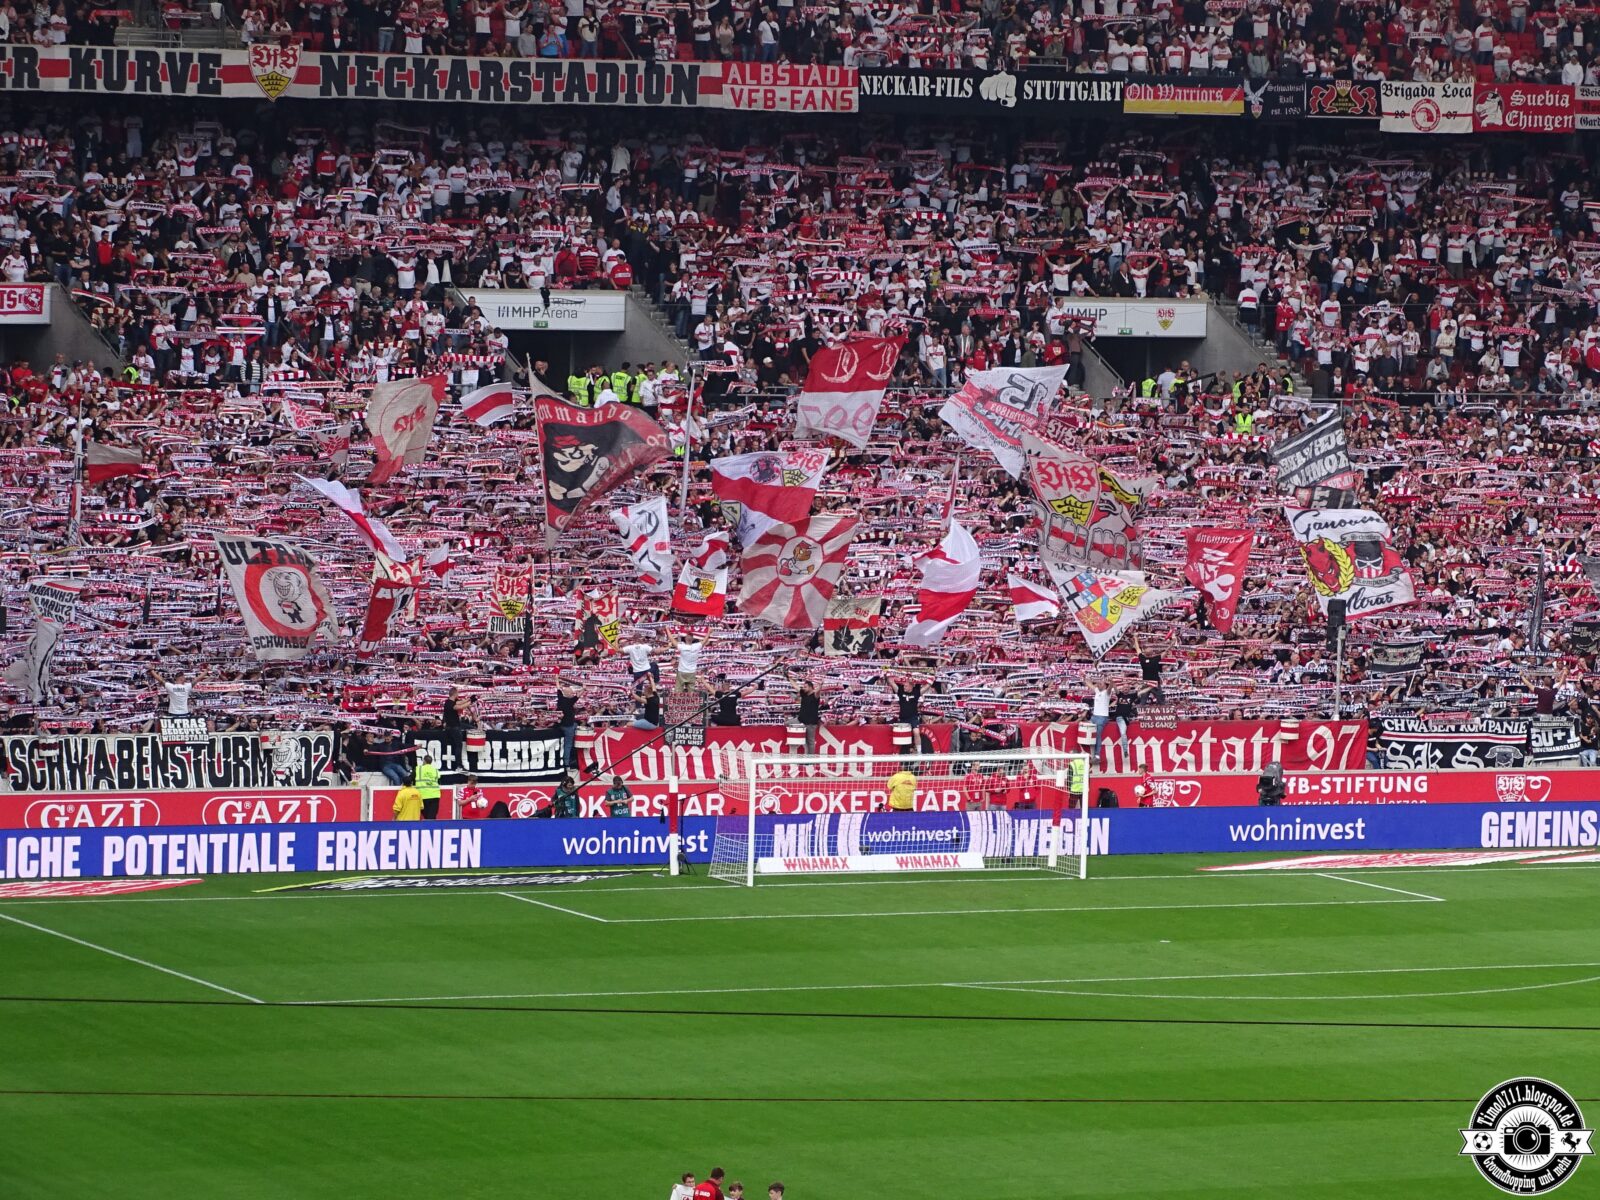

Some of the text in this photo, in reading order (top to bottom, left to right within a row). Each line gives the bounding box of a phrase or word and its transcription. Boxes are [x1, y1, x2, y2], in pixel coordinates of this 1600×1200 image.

[69, 48, 223, 95] KURVE
[320, 55, 700, 105] NECKARSTADION
[727, 64, 855, 86] ALBSTADT
[860, 74, 1124, 102] NECKAR-FILS STUTTGART
[1126, 83, 1153, 101] Old
[1157, 83, 1223, 103] Warriors
[1382, 83, 1473, 100] Brigada Loca
[1510, 90, 1570, 108] Suebia
[730, 88, 854, 111] VFB-FANS
[542, 306, 578, 319] Arena
[1036, 460, 1097, 492] VfB
[161, 718, 207, 728] ULTRAS
[1306, 724, 1361, 771] 97
[1531, 728, 1580, 747] 50+1
[477, 737, 565, 771] BLEIBT!
[1286, 776, 1428, 793] fB-STIFTUNG
[792, 789, 961, 813] JOKERTAR
[868, 826, 959, 843] wohninvest
[1230, 817, 1366, 841] wohninvest
[1482, 810, 1600, 848] GEMEINS
[103, 831, 297, 877] POTENTIALE
[317, 828, 482, 871] ERKENNEN
[896, 854, 962, 870] WINAMAX
[783, 856, 850, 872] WINAMAX
